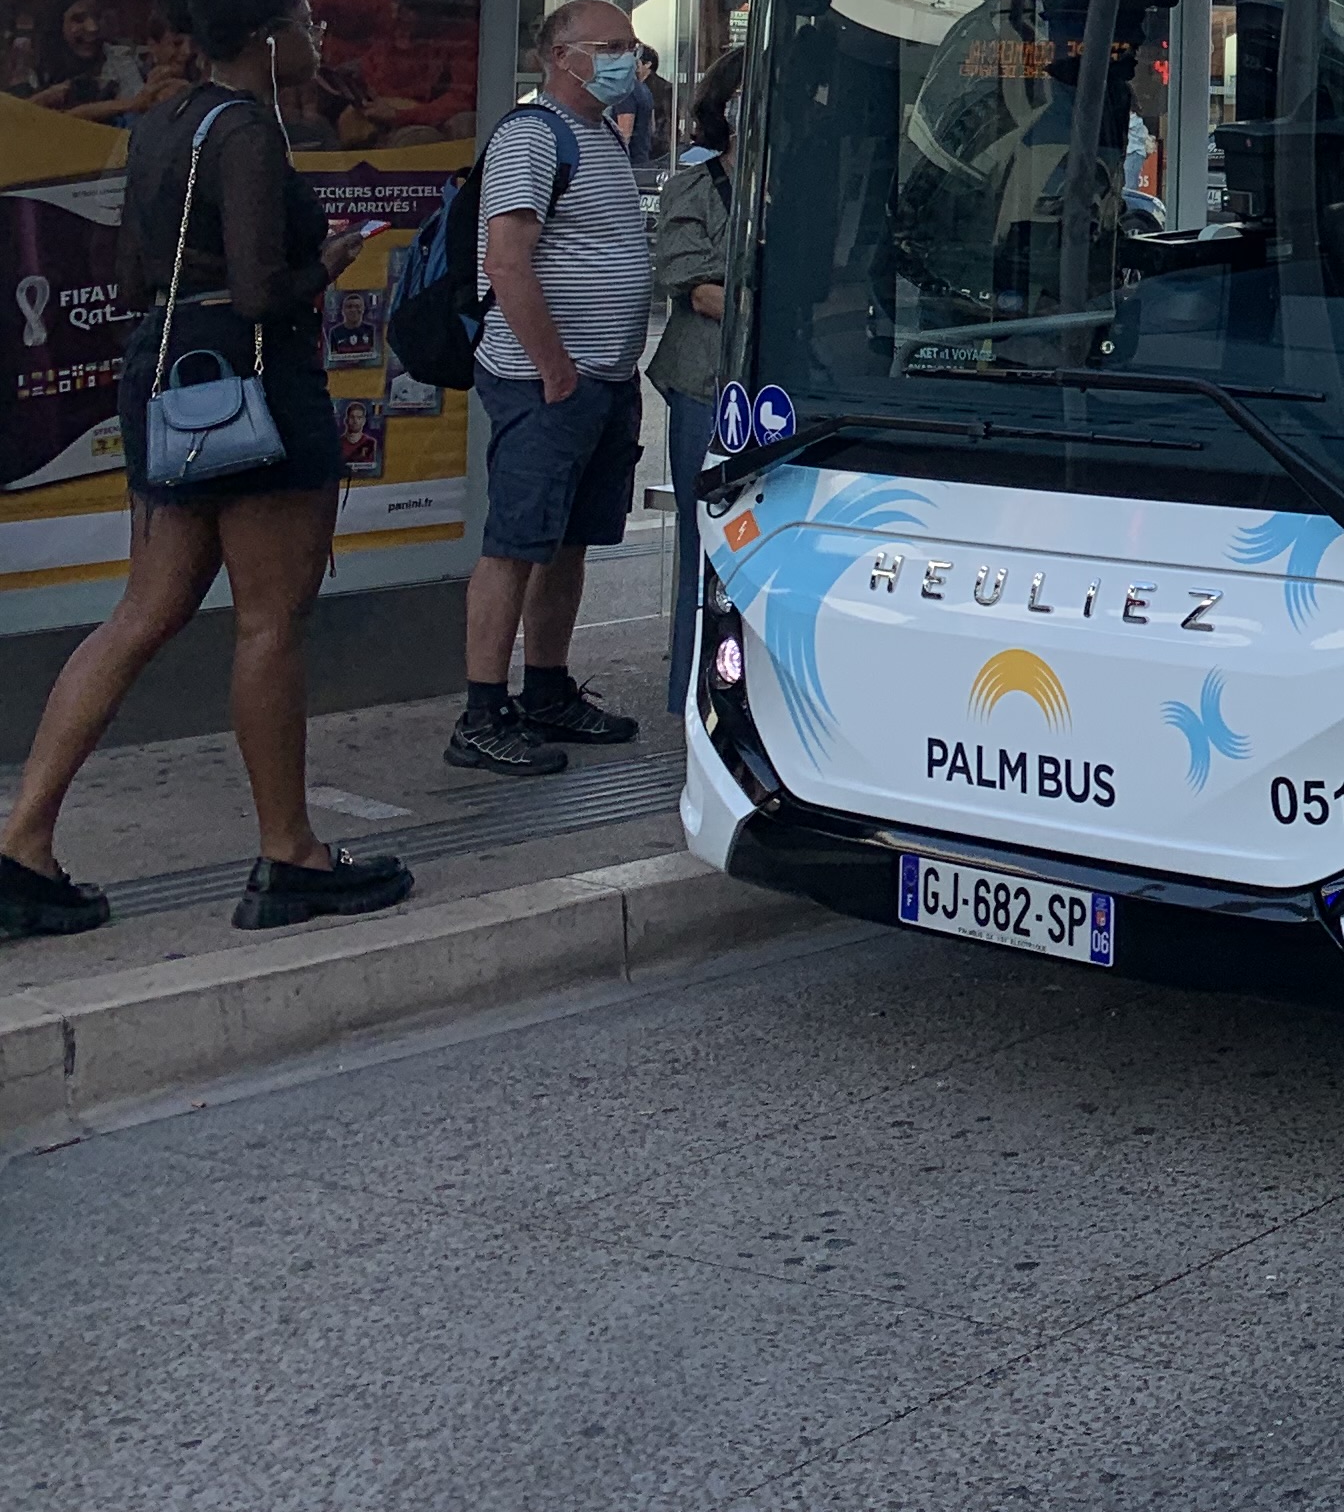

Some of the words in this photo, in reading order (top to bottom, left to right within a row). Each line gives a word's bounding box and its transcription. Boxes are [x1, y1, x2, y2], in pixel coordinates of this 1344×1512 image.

[375, 186, 444, 198] OFFICIEL
[347, 199, 410, 213] ARRIVÉS
[60, 286, 105, 307] FIFA
[387, 496, 434, 513] panini.fr
[870, 552, 1223, 632] HEULIEZ
[927, 738, 1030, 794] PALM
[1037, 755, 1116, 808] BUS
[923, 867, 1087, 947] GJ-682-SP
[1092, 929, 1110, 954] 06
